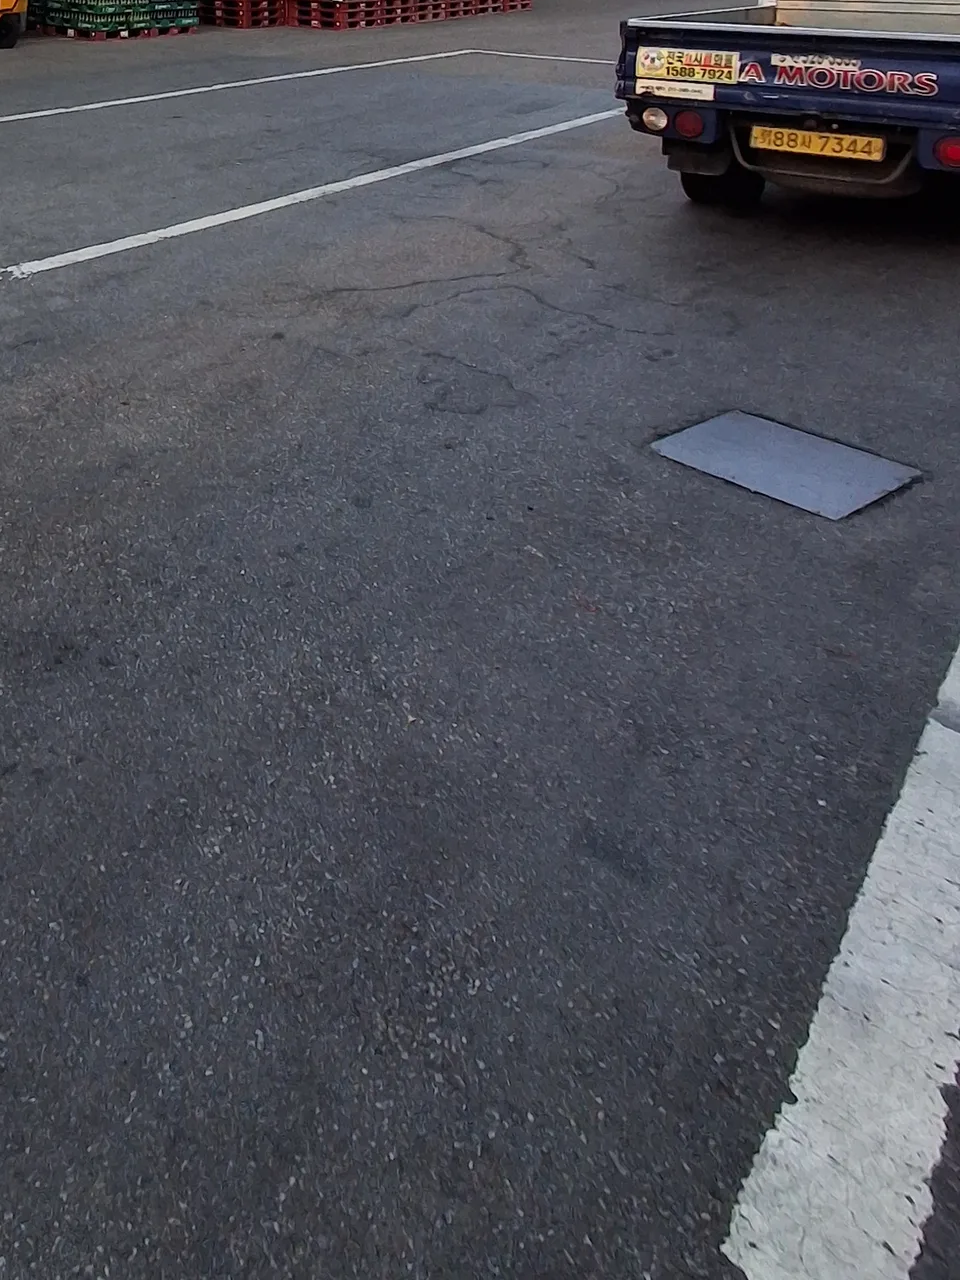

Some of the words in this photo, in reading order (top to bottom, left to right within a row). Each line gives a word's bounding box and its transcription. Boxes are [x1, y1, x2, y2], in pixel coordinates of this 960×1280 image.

[665, 65, 734, 81] 1588-7924
[774, 65, 939, 97] MOTORS
[818, 135, 874, 157] 7344
